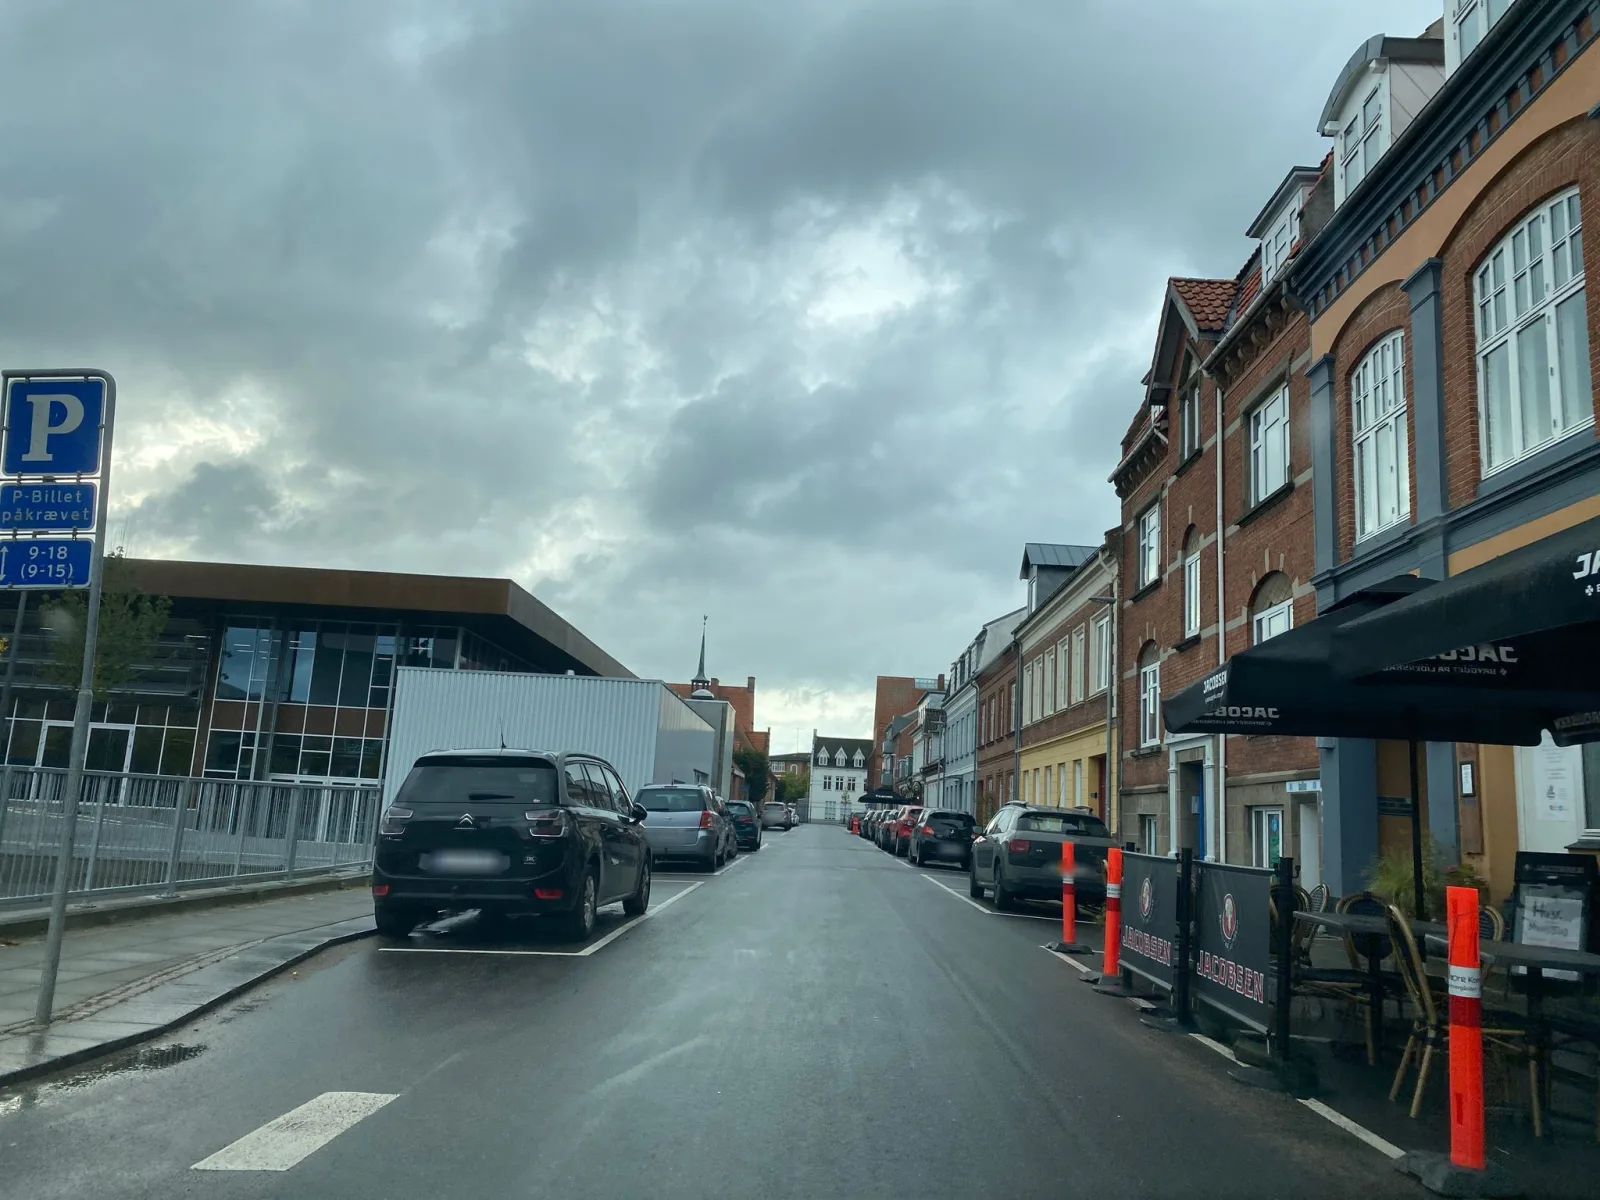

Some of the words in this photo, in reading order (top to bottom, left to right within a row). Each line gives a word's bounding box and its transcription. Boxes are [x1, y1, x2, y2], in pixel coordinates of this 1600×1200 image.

[21, 393, 85, 462] P
[12, 489, 83, 504] P-Billet
[1, 507, 90, 524] påkrævet
[29, 545, 68, 560] 9-18
[20, 562, 73, 580] (9-15)
[1122, 924, 1172, 967] JACOBSEN
[1196, 949, 1265, 1004] JACOBSEN
